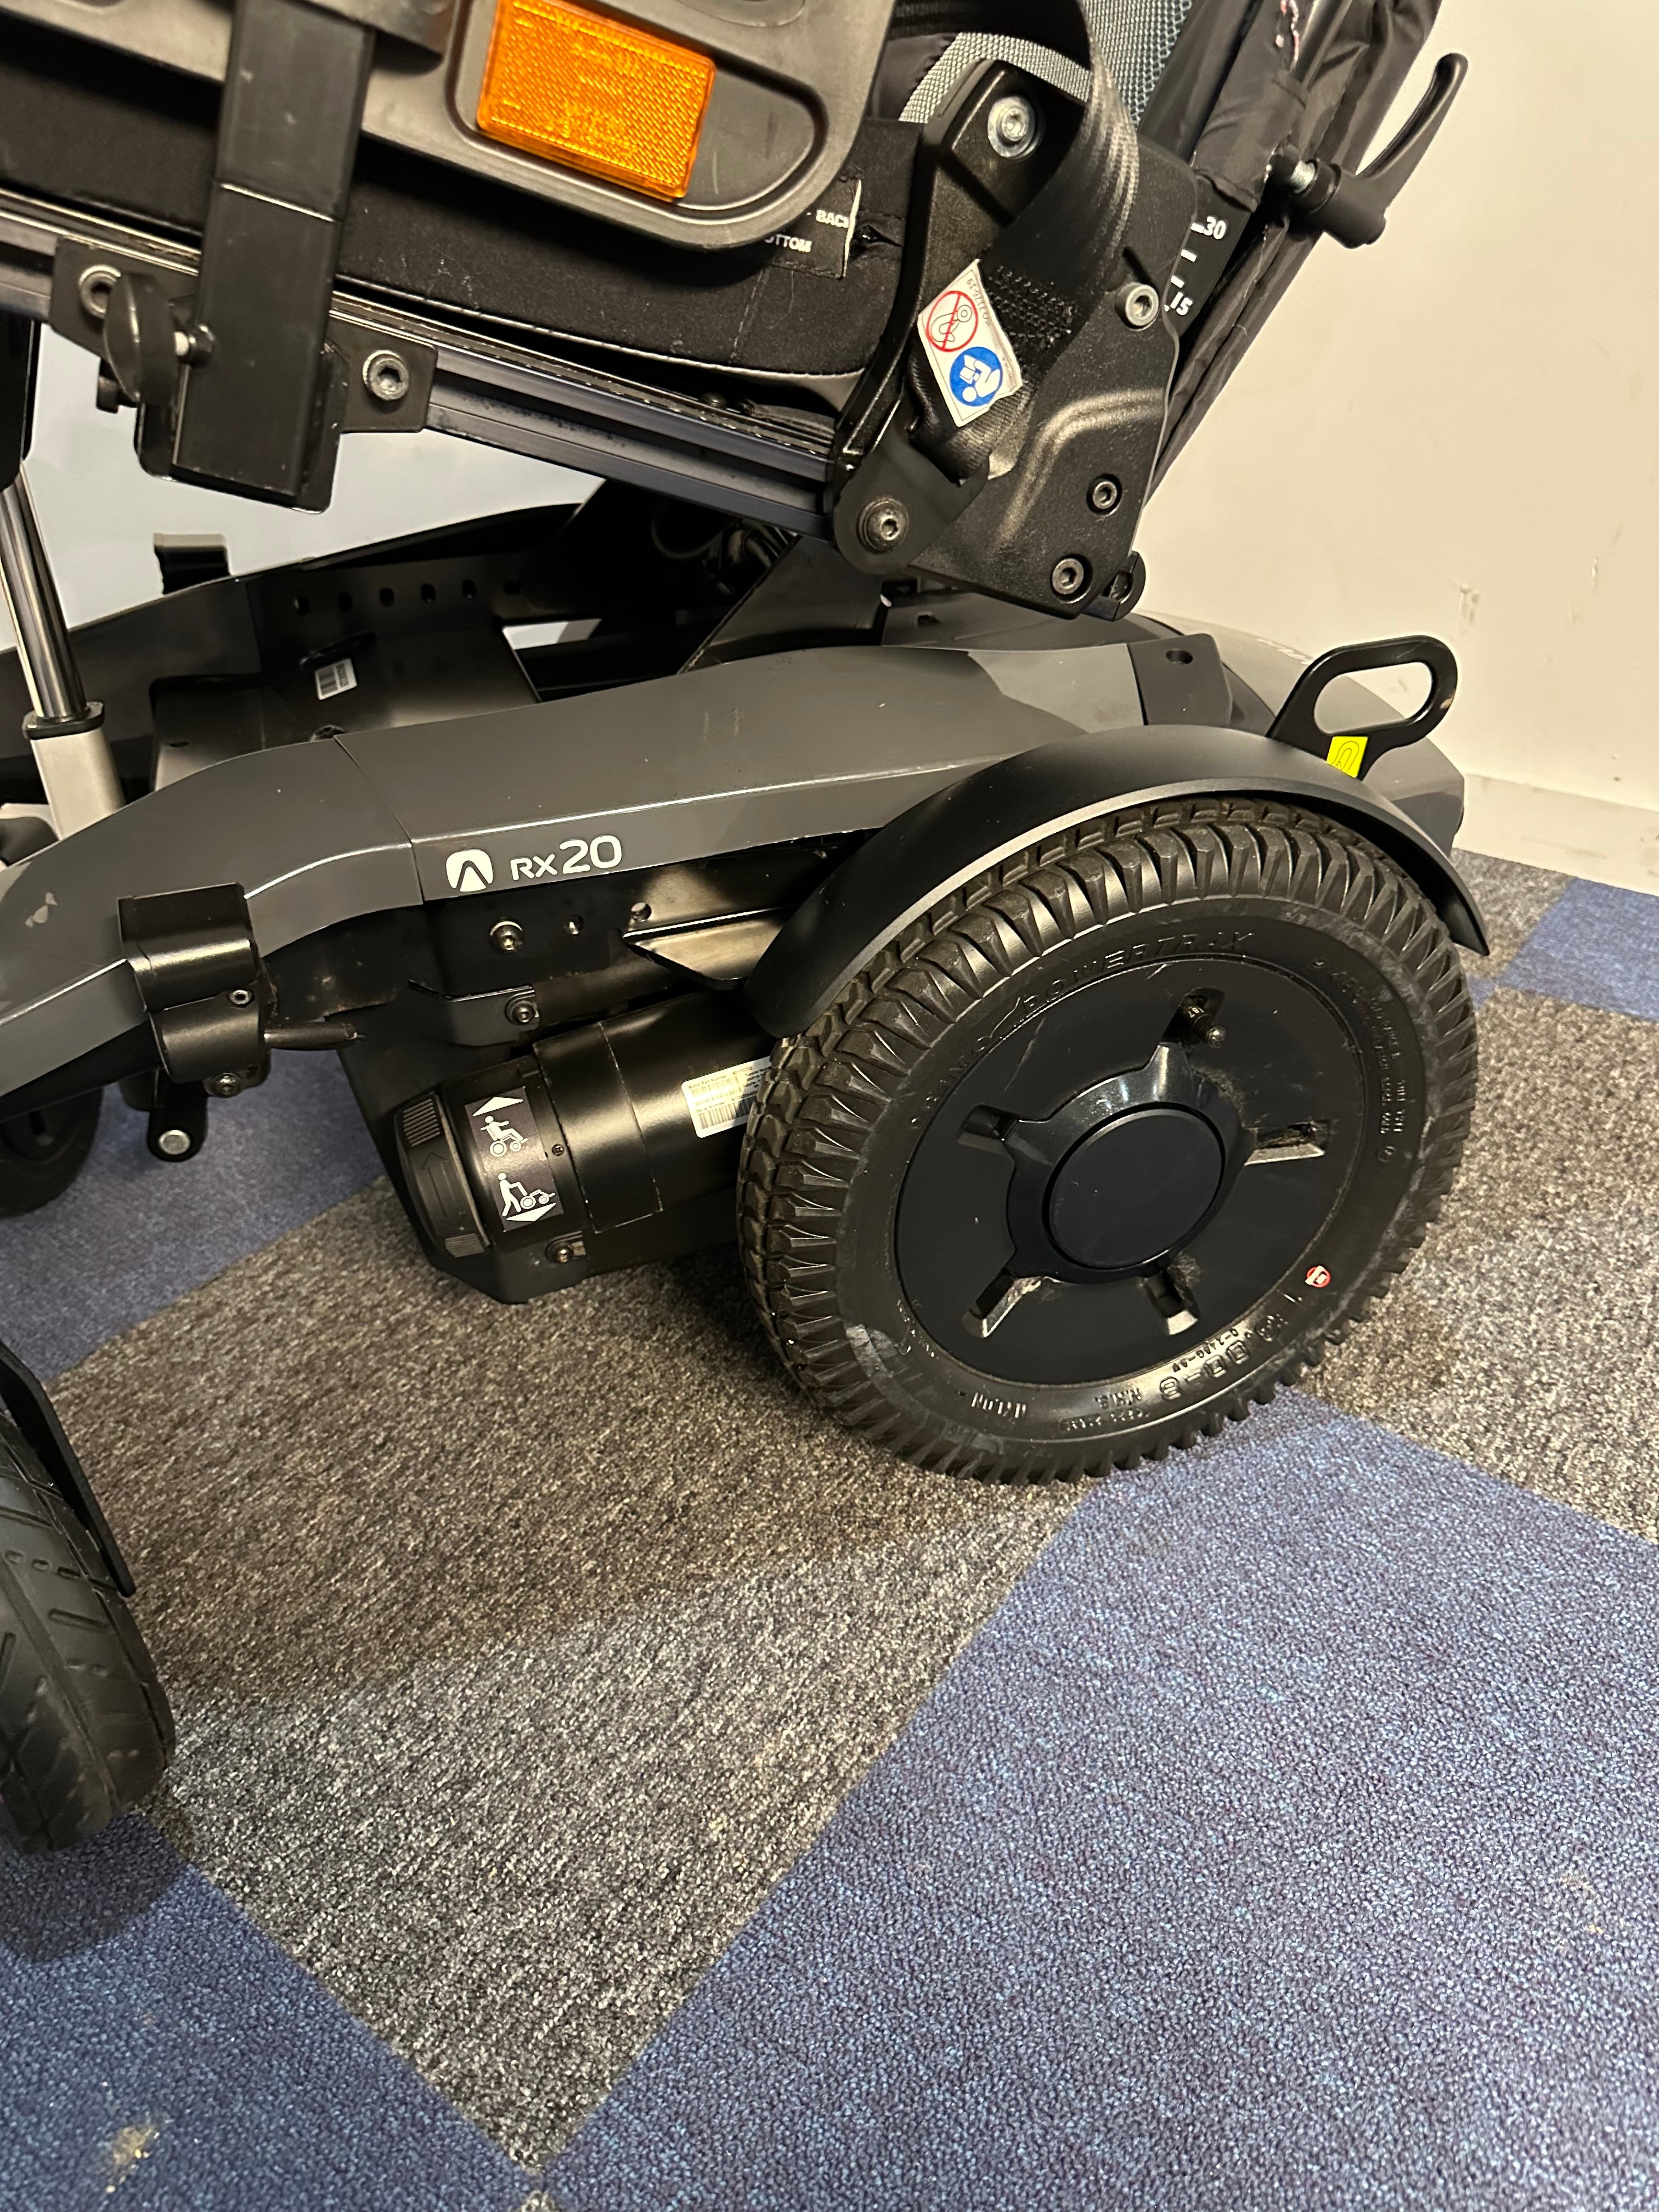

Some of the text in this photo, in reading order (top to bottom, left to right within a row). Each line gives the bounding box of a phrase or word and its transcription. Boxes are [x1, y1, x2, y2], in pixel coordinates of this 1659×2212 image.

[1203, 216, 1226, 240] 30
[1170, 292, 1193, 315] 15
[510, 834, 622, 881] RX20
